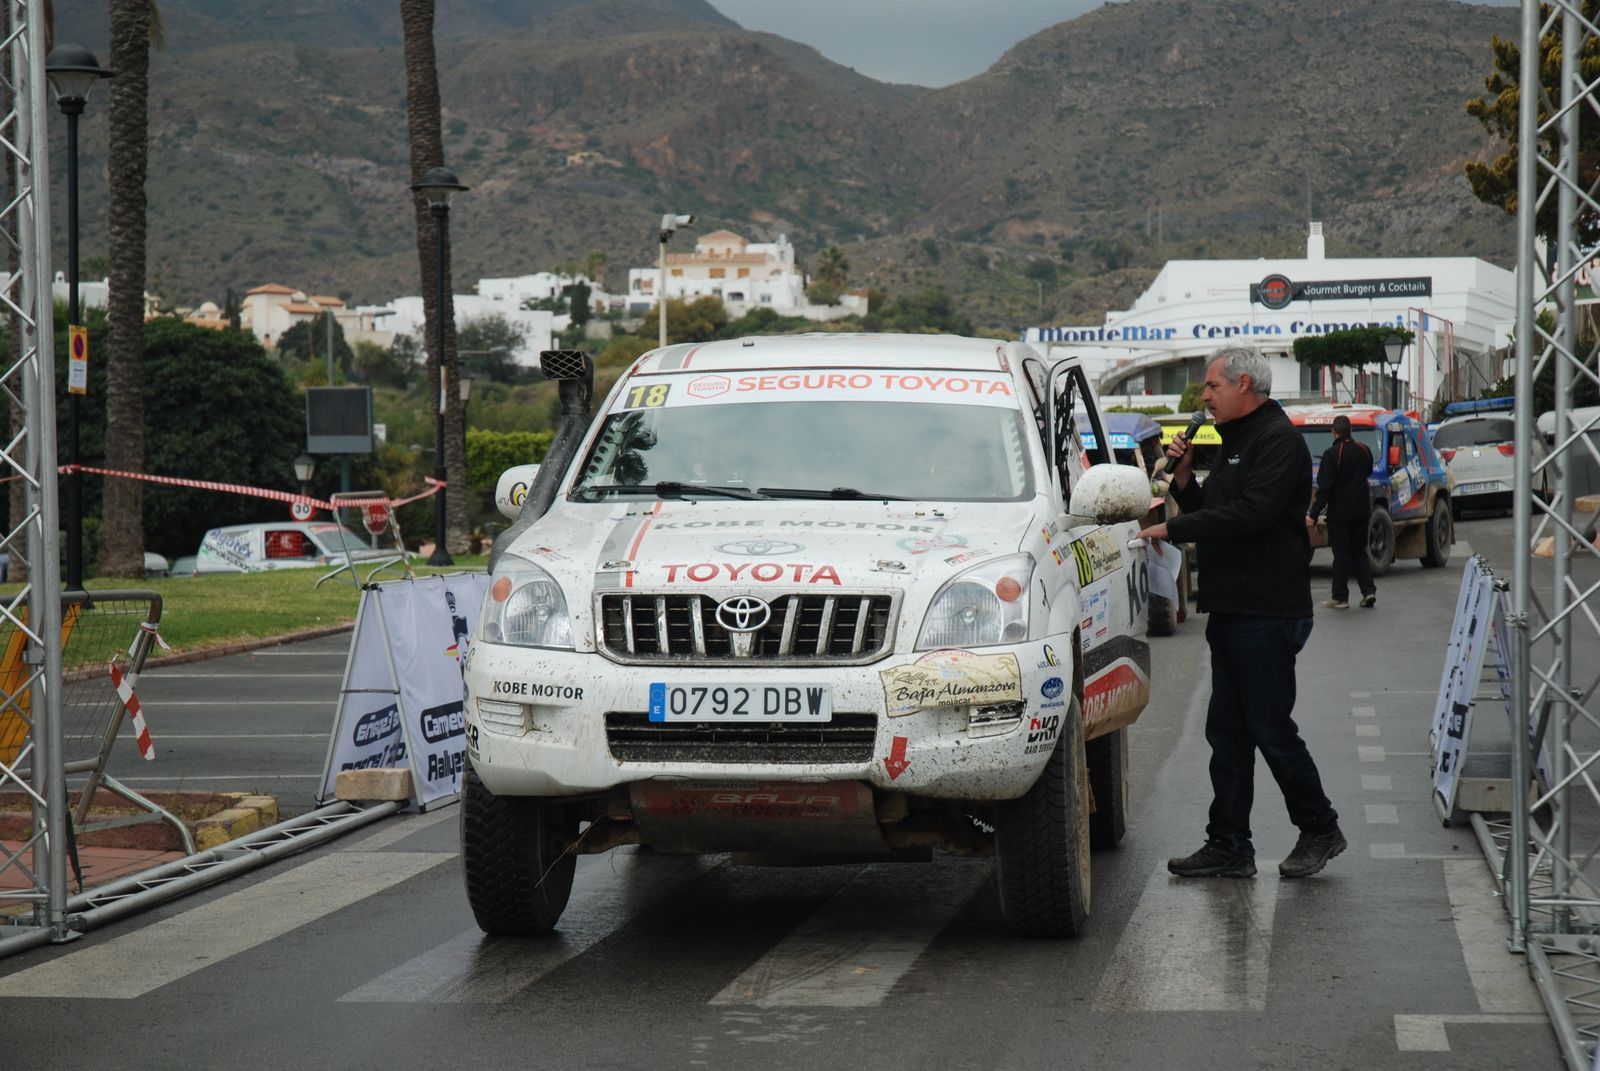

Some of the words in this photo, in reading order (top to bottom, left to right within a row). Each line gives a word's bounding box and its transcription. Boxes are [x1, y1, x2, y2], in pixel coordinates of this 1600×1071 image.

[1304, 285, 1343, 296] Gourmet
[1343, 284, 1375, 295] Burgers
[1388, 282, 1426, 292] Cocktails
[1193, 321, 1281, 339] Centro
[736, 374, 873, 392] SEGURO
[880, 375, 1011, 397] TOYOTA
[630, 384, 668, 408] 18
[295, 505, 310, 514] 30
[654, 520, 764, 530] KOBE
[779, 520, 934, 533] MOTOR
[1071, 540, 1093, 586] 18
[661, 562, 842, 586] TOYOTA
[493, 680, 528, 696] KOBE
[531, 683, 584, 700] MOTOR
[894, 686, 935, 704] Baja
[937, 681, 1016, 701] Almanzora
[653, 705, 661, 715] E
[669, 687, 750, 716] 0792
[763, 687, 823, 716] DBW
[711, 793, 840, 805] BAJA
